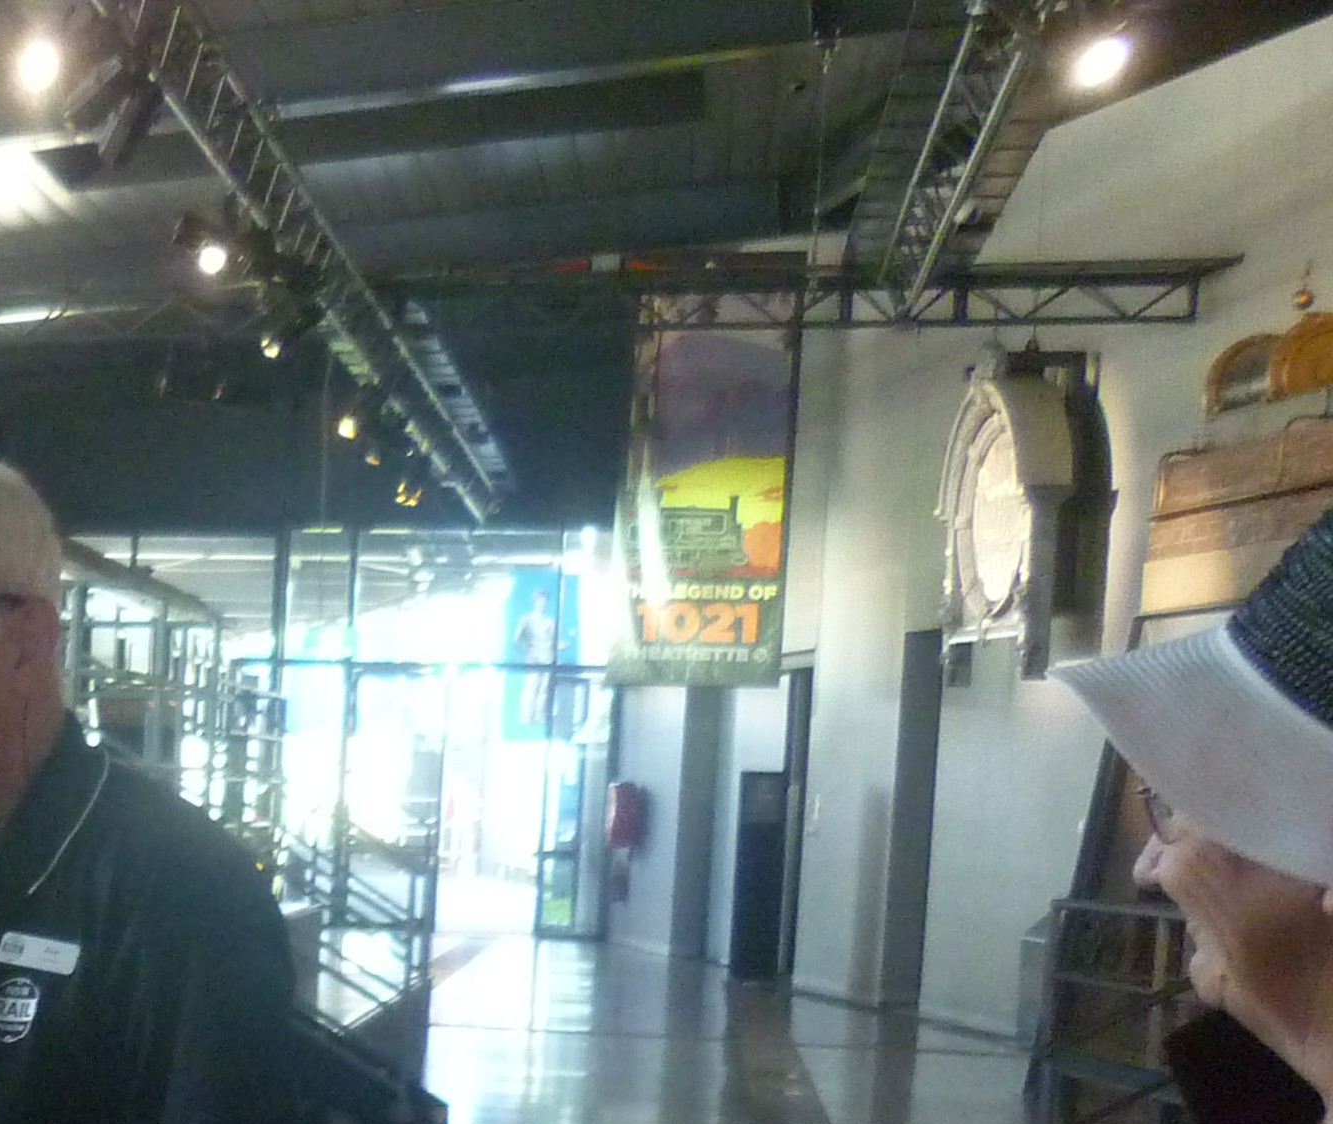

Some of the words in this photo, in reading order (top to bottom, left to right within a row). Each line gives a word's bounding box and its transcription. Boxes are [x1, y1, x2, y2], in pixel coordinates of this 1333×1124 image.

[669, 583, 745, 599] LEGEND
[748, 584, 778, 601] OF
[636, 601, 761, 643] 1021
